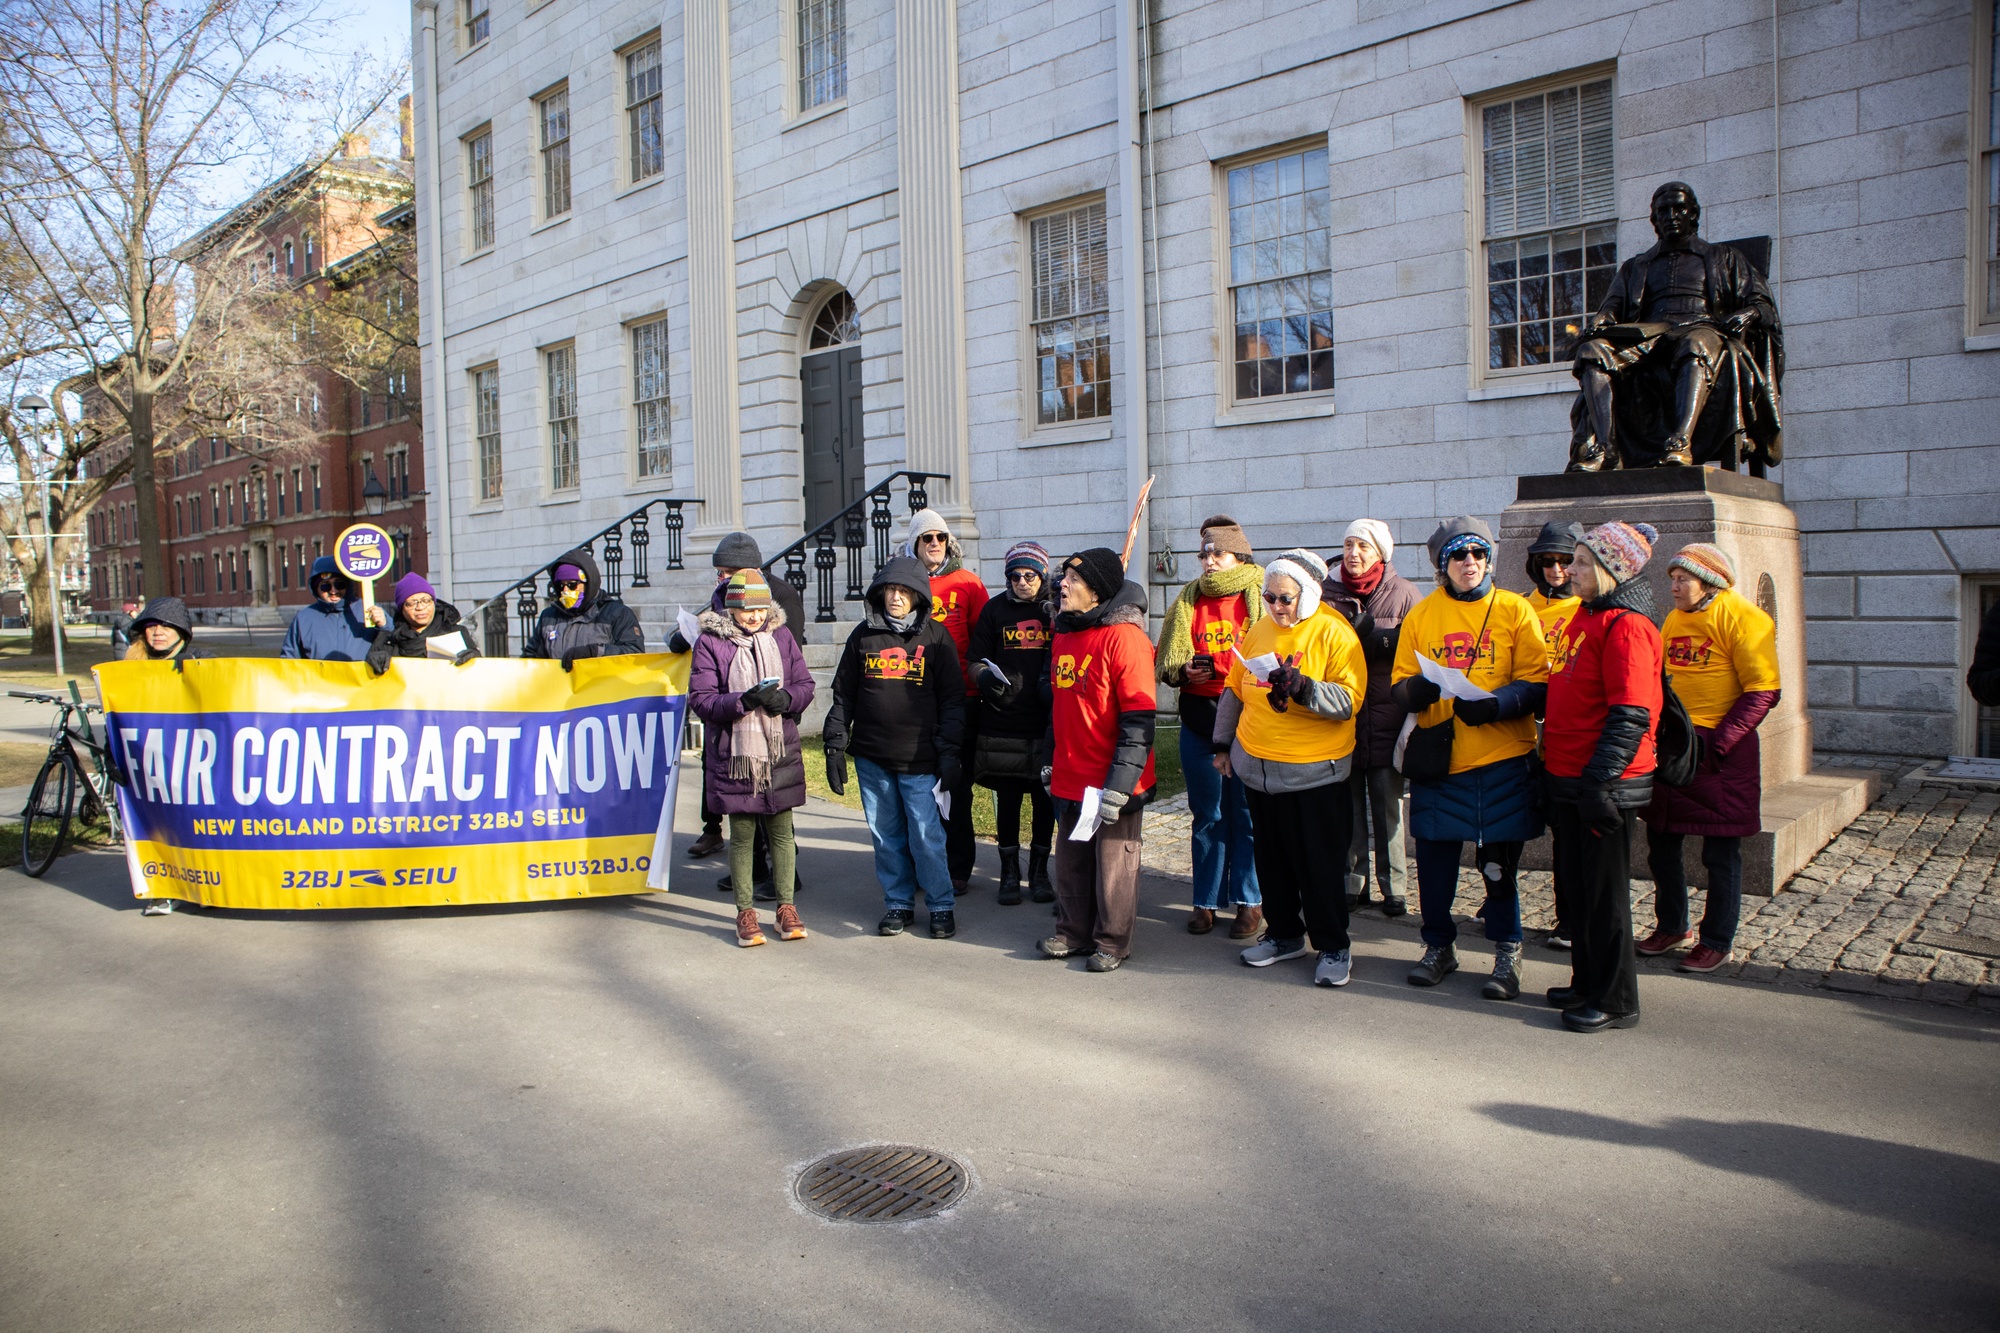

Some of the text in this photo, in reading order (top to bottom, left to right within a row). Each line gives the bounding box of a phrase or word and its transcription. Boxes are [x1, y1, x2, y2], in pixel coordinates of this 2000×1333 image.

[347, 533, 381, 546] 32BJ
[349, 558, 383, 572] SEIU
[1006, 630, 1052, 641] VOCAL
[1431, 646, 1486, 659] VOCAL
[1667, 646, 1701, 663] OCAL
[868, 658, 918, 672] VOCAL
[118, 711, 675, 807] FAIR CONTRACT NOW!
[193, 807, 586, 836] NEW ENGLAND DISTRICT 32BJ SEIU
[141, 860, 222, 886] @32BJSEIU
[281, 866, 458, 889] 32BJ SEIU
